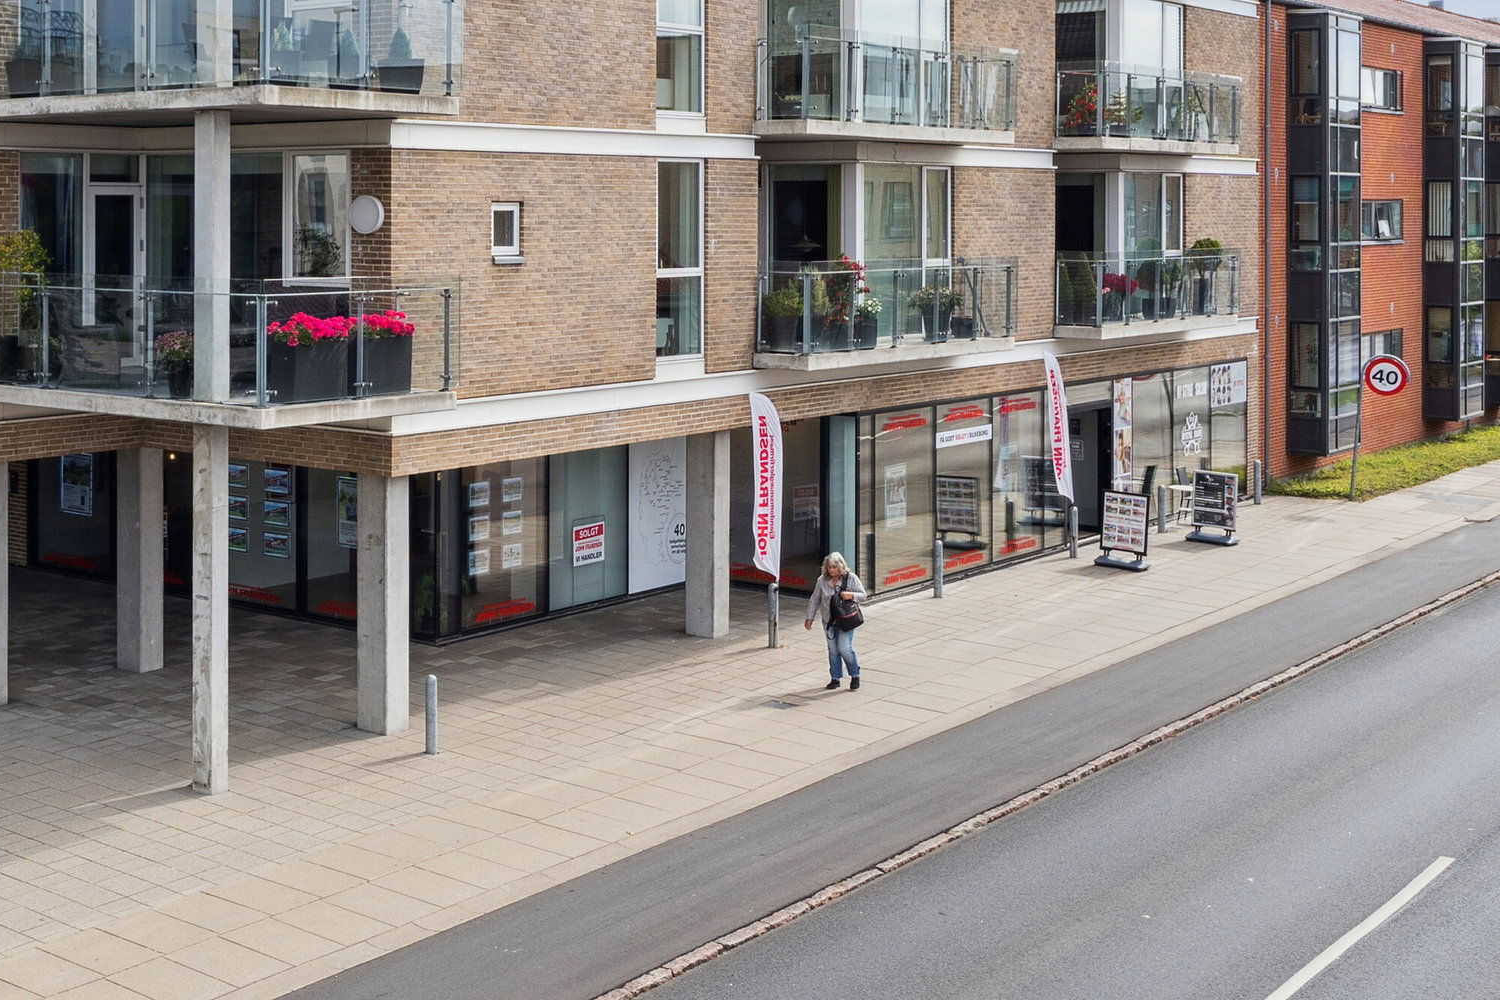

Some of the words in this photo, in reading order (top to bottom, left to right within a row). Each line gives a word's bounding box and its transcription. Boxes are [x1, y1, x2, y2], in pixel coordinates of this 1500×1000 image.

[1371, 369, 1398, 385] 40
[579, 526, 599, 539] SOLGT
[674, 523, 686, 536] 40
[581, 551, 603, 562] HANDLER
[497, 601, 535, 616] FRANDSEN
